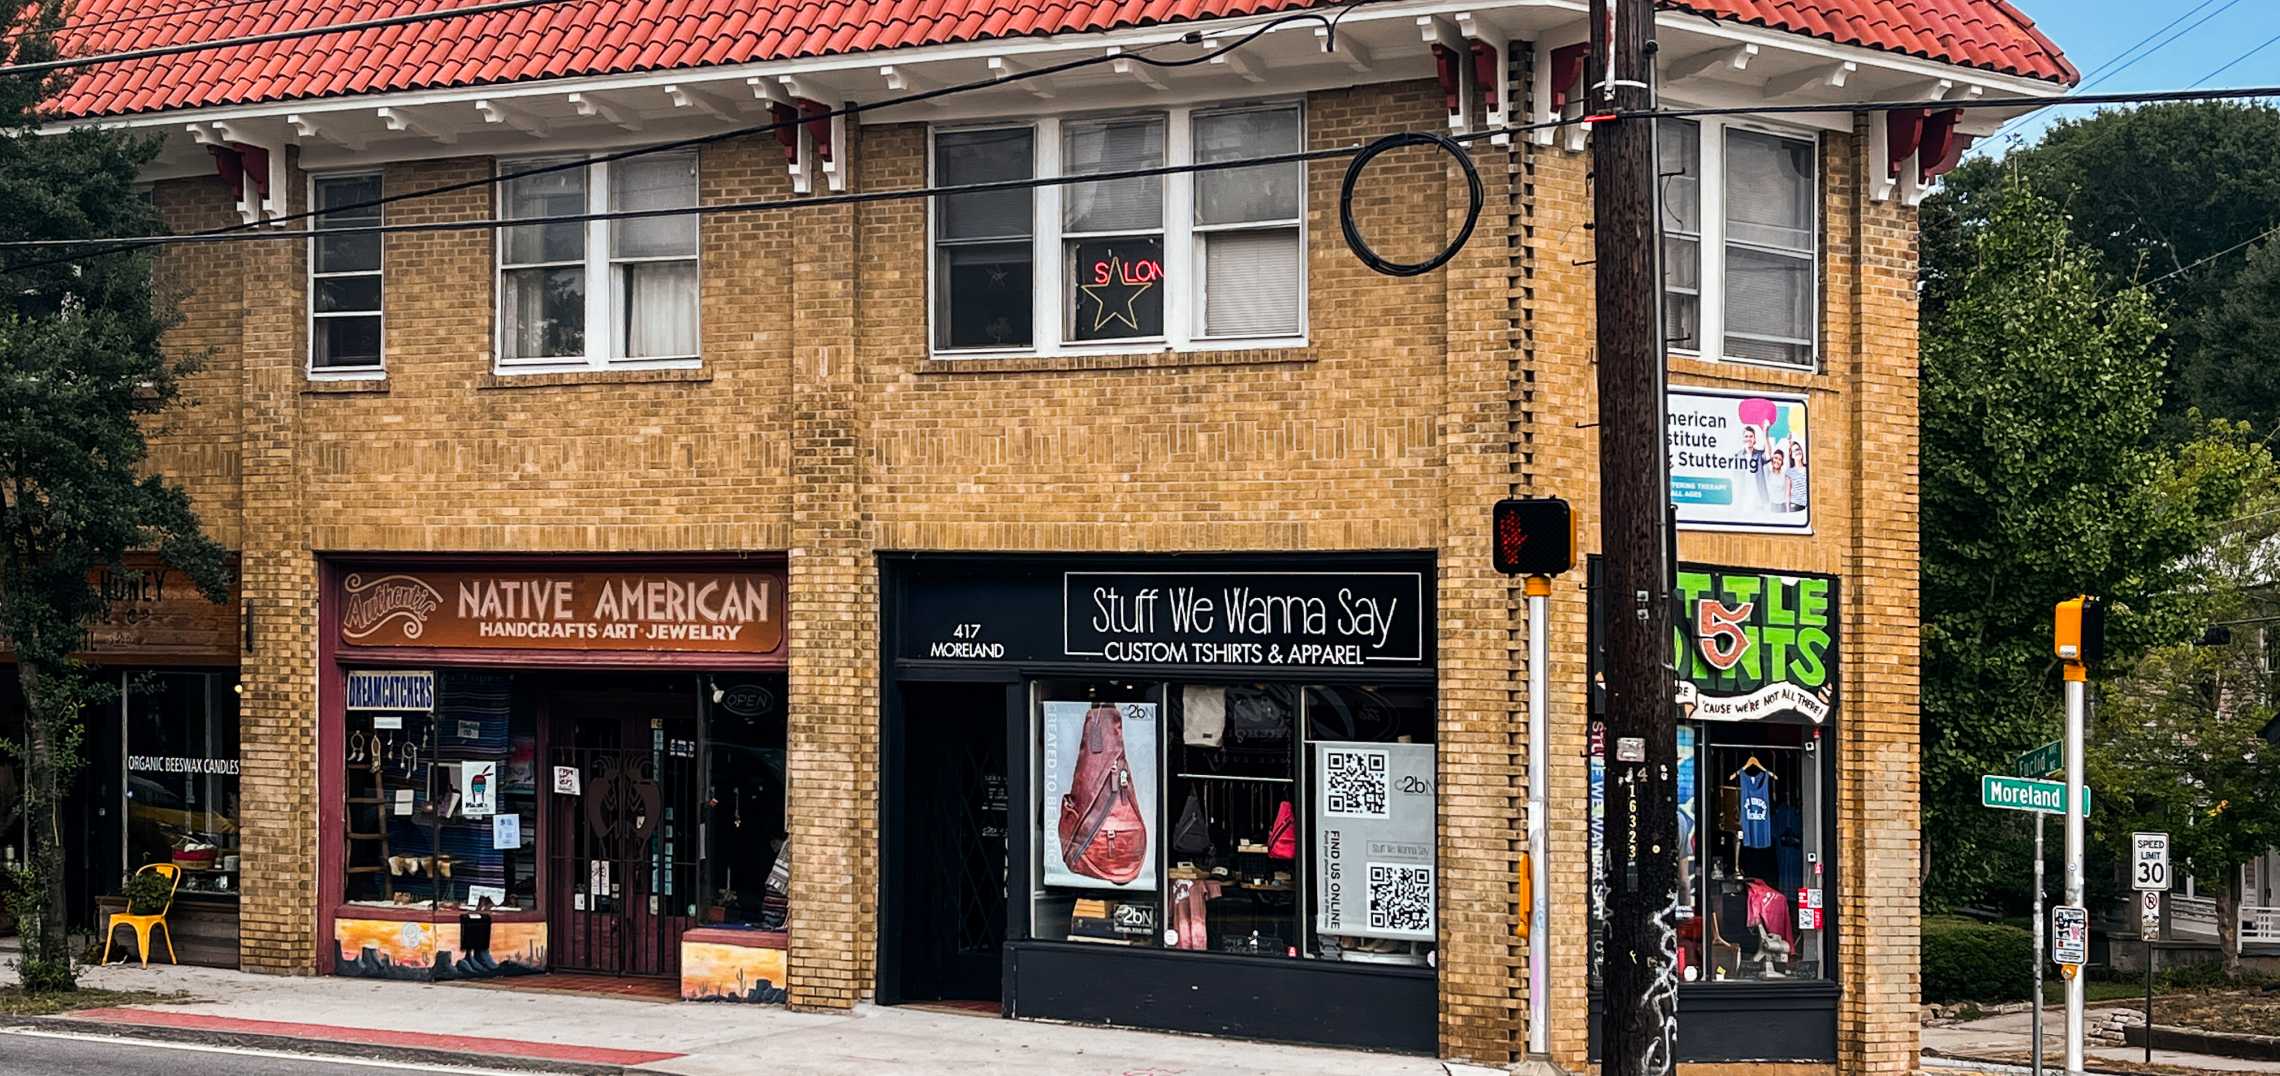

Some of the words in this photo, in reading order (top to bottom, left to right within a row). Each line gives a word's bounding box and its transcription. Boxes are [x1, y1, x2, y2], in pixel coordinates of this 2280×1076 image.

[1667, 411, 1727, 428] merican
[1667, 431, 1717, 448] stitute
[1678, 452, 1759, 473] Stuttering
[344, 583, 437, 629] Authentic
[457, 578, 574, 620] NATIVE
[593, 577, 769, 623] AMERICAN
[1676, 571, 1829, 627] TTLE
[1092, 586, 1160, 634] Stuff
[1168, 586, 1214, 634] We
[1223, 586, 1326, 636] Wanna
[1337, 587, 1398, 649] Say
[479, 621, 598, 639] HANDCRAFTS
[602, 624, 638, 639] ART
[645, 624, 744, 641] JEWELRY
[952, 623, 982, 640] 417
[1698, 598, 1755, 671] 5
[930, 641, 1005, 659] MORELAND
[1104, 642, 1189, 663] CUSTOM
[1191, 643, 1263, 664] TSHIRTS
[1267, 644, 1284, 664] &
[1287, 644, 1365, 665] APPAREL
[348, 674, 434, 709] DREAMCATCHERS
[726, 694, 768, 708] OPEN
[1702, 701, 1732, 714] 'CAUSE
[1735, 699, 1760, 713] WE'RE
[1763, 690, 1780, 707] NOT
[1781, 688, 1796, 702] ALL
[1797, 691, 1824, 718] THERE!
[1046, 704, 1058, 768] CREATED
[128, 755, 165, 772] ORGANIC
[165, 757, 202, 773] BEESWAX
[203, 758, 240, 775] CANDLES
[2019, 752, 2046, 777] Euclid
[1046, 773, 1058, 792] TO
[1990, 781, 2061, 807] Moreland
[1046, 796, 1058, 816] BE
[1330, 830, 1341, 859] FIND
[2137, 840, 2165, 849] SPEED
[2140, 851, 2161, 861] LIMIT
[1330, 863, 1341, 880] US
[2137, 862, 2165, 884] 30
[1330, 883, 1341, 929] ONLINE
